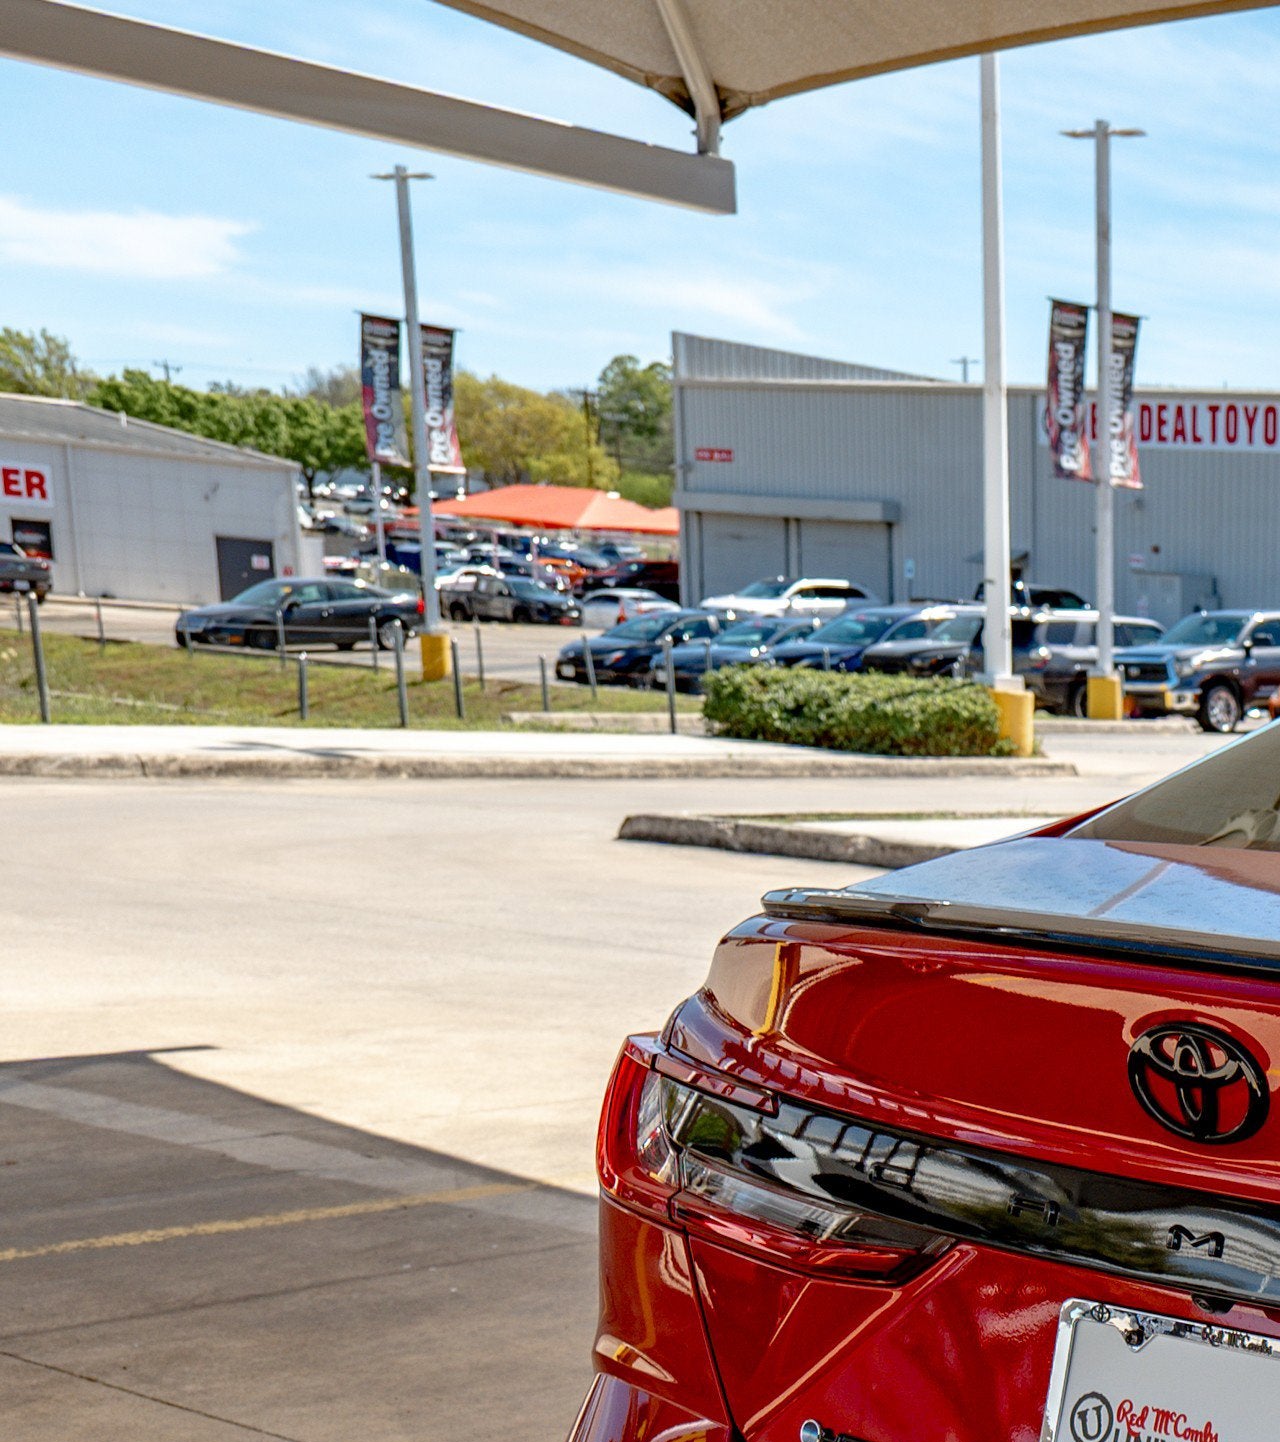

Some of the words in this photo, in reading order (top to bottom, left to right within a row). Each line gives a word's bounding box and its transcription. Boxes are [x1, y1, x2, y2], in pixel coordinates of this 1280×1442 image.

[367, 348, 393, 422] Owned
[424, 357, 444, 428] Owned
[1054, 341, 1076, 426] Owned
[1059, 431, 1080, 471] Pre
[1109, 438, 1129, 478] Pre
[2, 467, 48, 500] ER
[1116, 1398, 1149, 1438] Red
